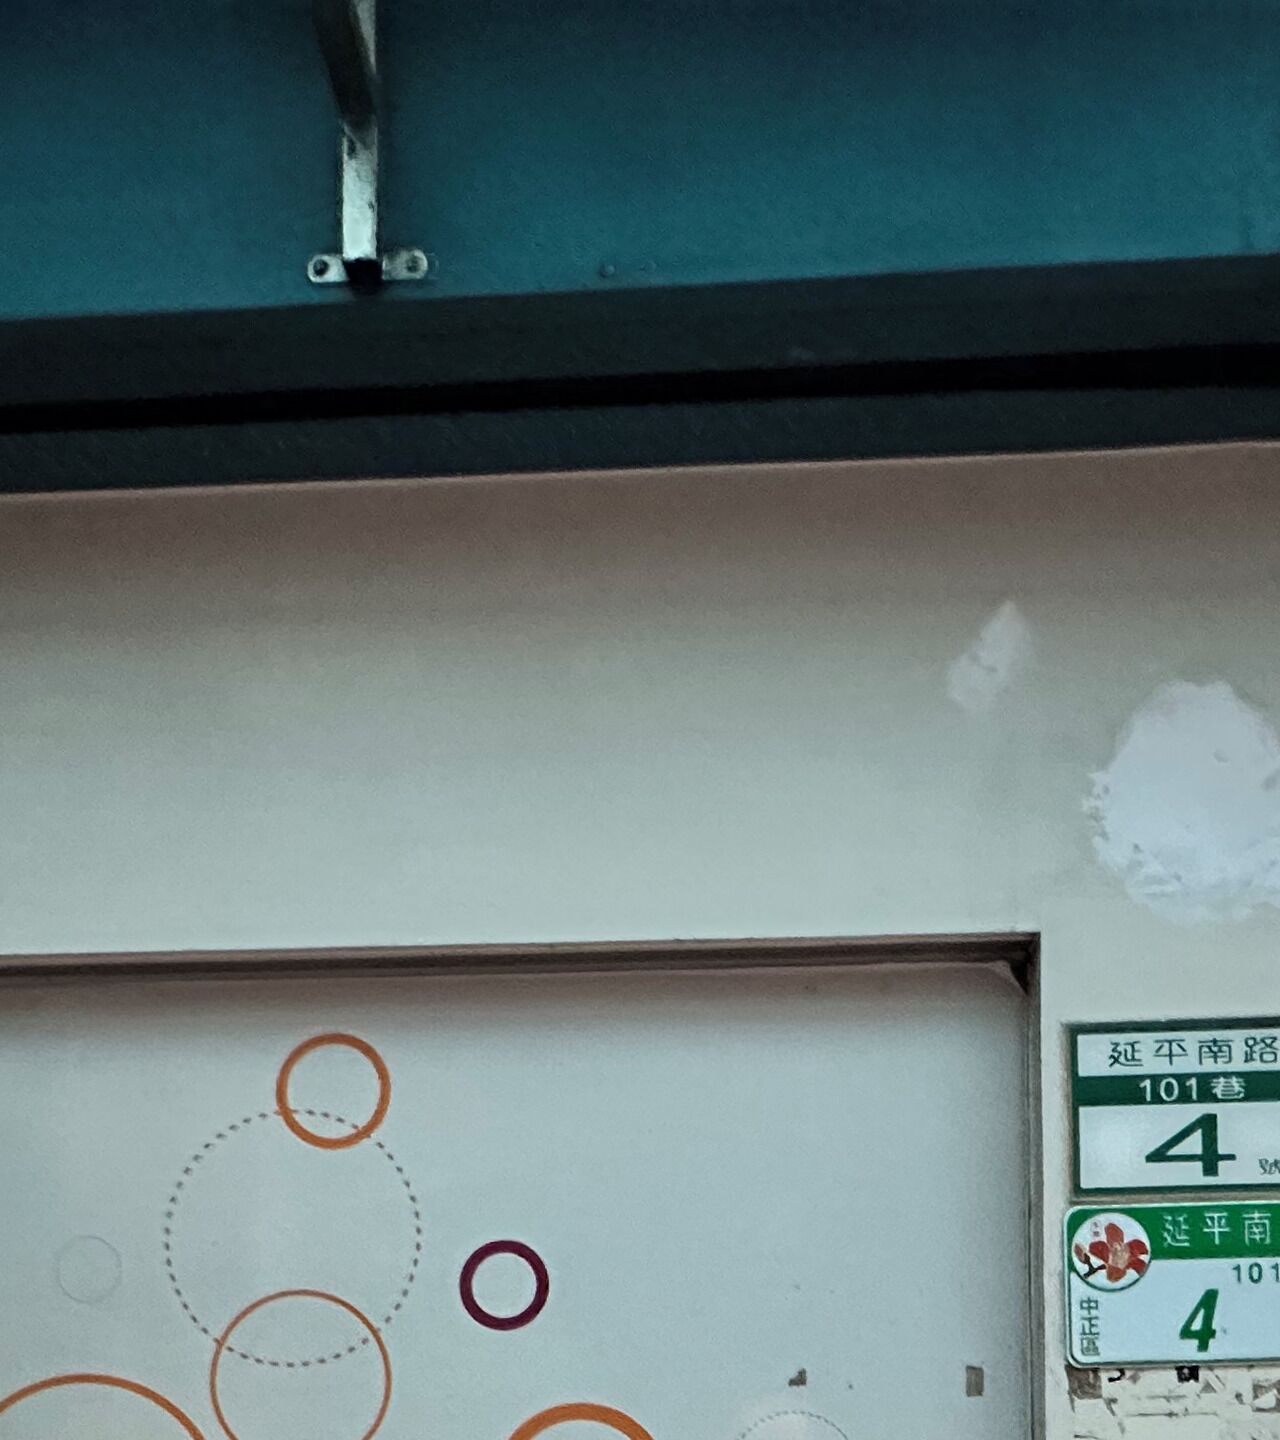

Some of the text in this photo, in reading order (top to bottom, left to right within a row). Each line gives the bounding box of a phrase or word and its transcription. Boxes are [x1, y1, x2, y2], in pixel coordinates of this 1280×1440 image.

[1108, 1035, 1280, 1069] 延平南路
[1139, 1076, 1246, 1102] 101巷
[1145, 1112, 1237, 1177] 4
[1079, 1297, 1101, 1357] 中正區
[1179, 1288, 1219, 1353] 4
